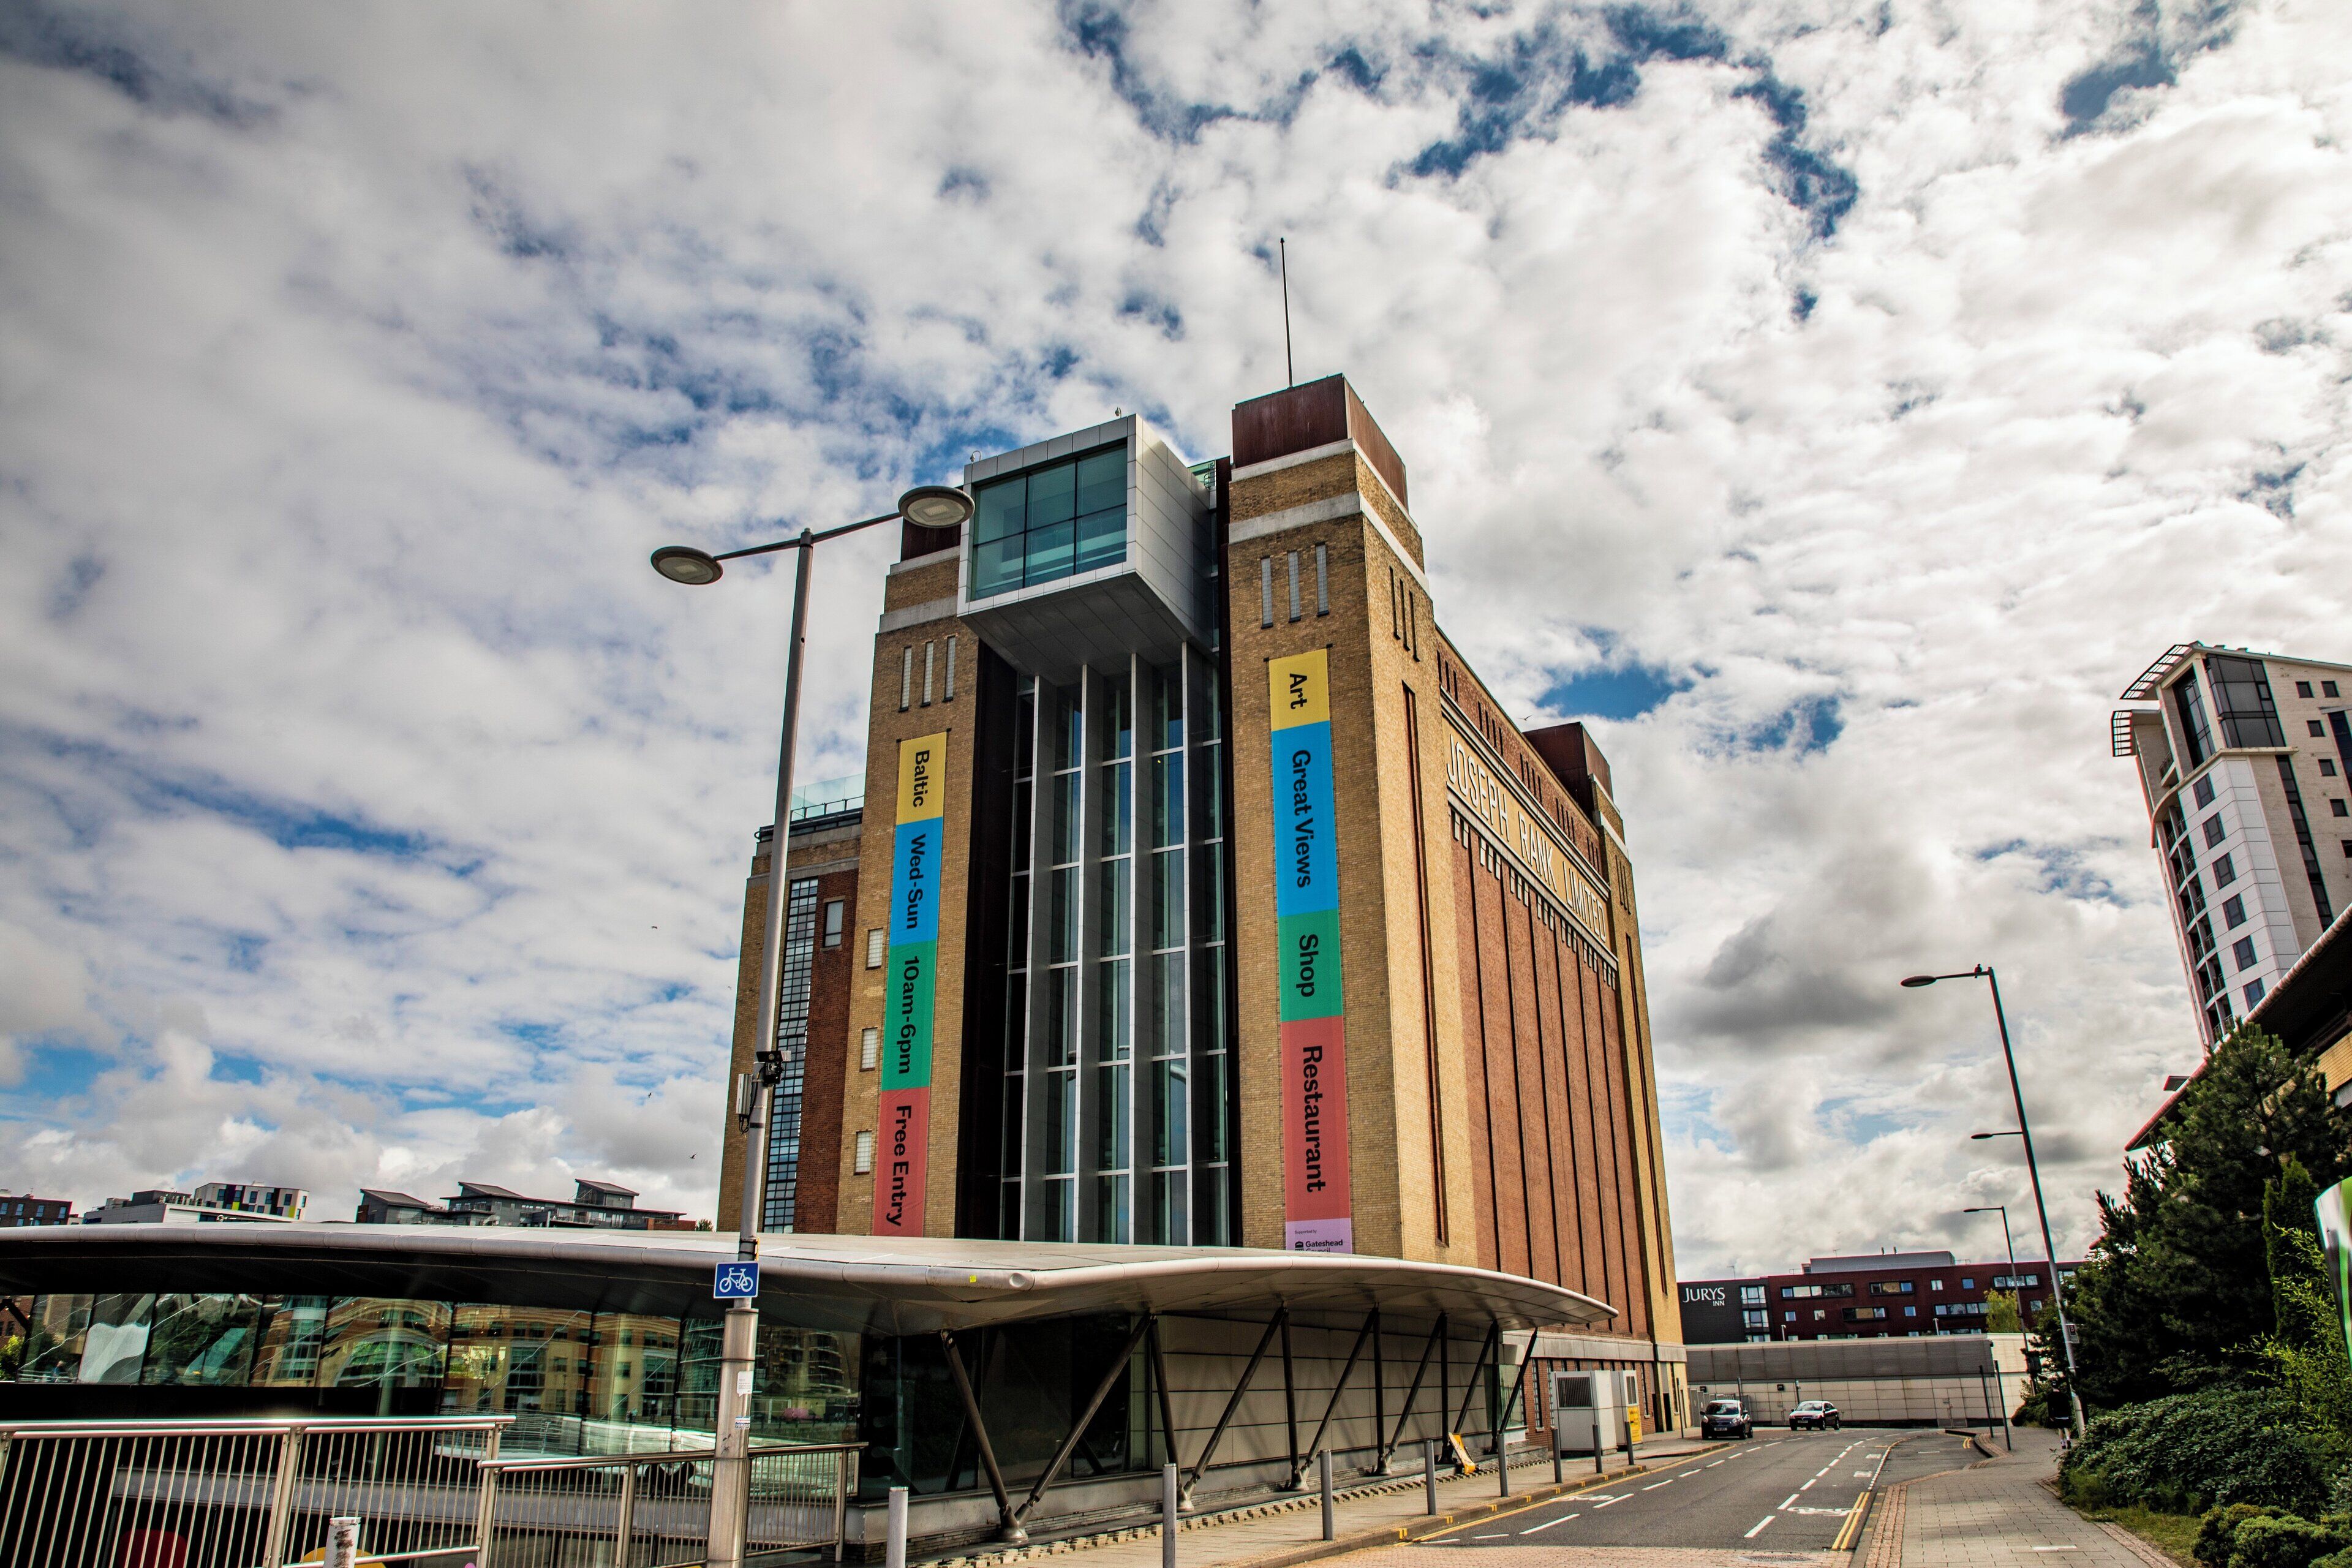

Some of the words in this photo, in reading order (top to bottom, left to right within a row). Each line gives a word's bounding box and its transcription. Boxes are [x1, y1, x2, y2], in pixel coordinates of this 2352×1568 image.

[1289, 673, 1308, 710] Art
[913, 750, 930, 808] Baltic
[1292, 750, 1312, 815] Great
[1295, 817, 1314, 888] Views
[1447, 734, 1510, 842] JOSEPH
[1518, 811, 1557, 892] RANK
[1562, 861, 1607, 943] LIMITED
[907, 833, 926, 929] Wed-Sun
[1295, 933, 1319, 997] Shop
[896, 956, 920, 1074] 10am-6pm
[894, 1105, 912, 1156] Free
[1303, 1046, 1326, 1193] Restaurant
[886, 1161, 909, 1227] Entry
[1305, 1238, 1343, 1248] Gateshead
[1683, 1287, 1725, 1303] JURYS
